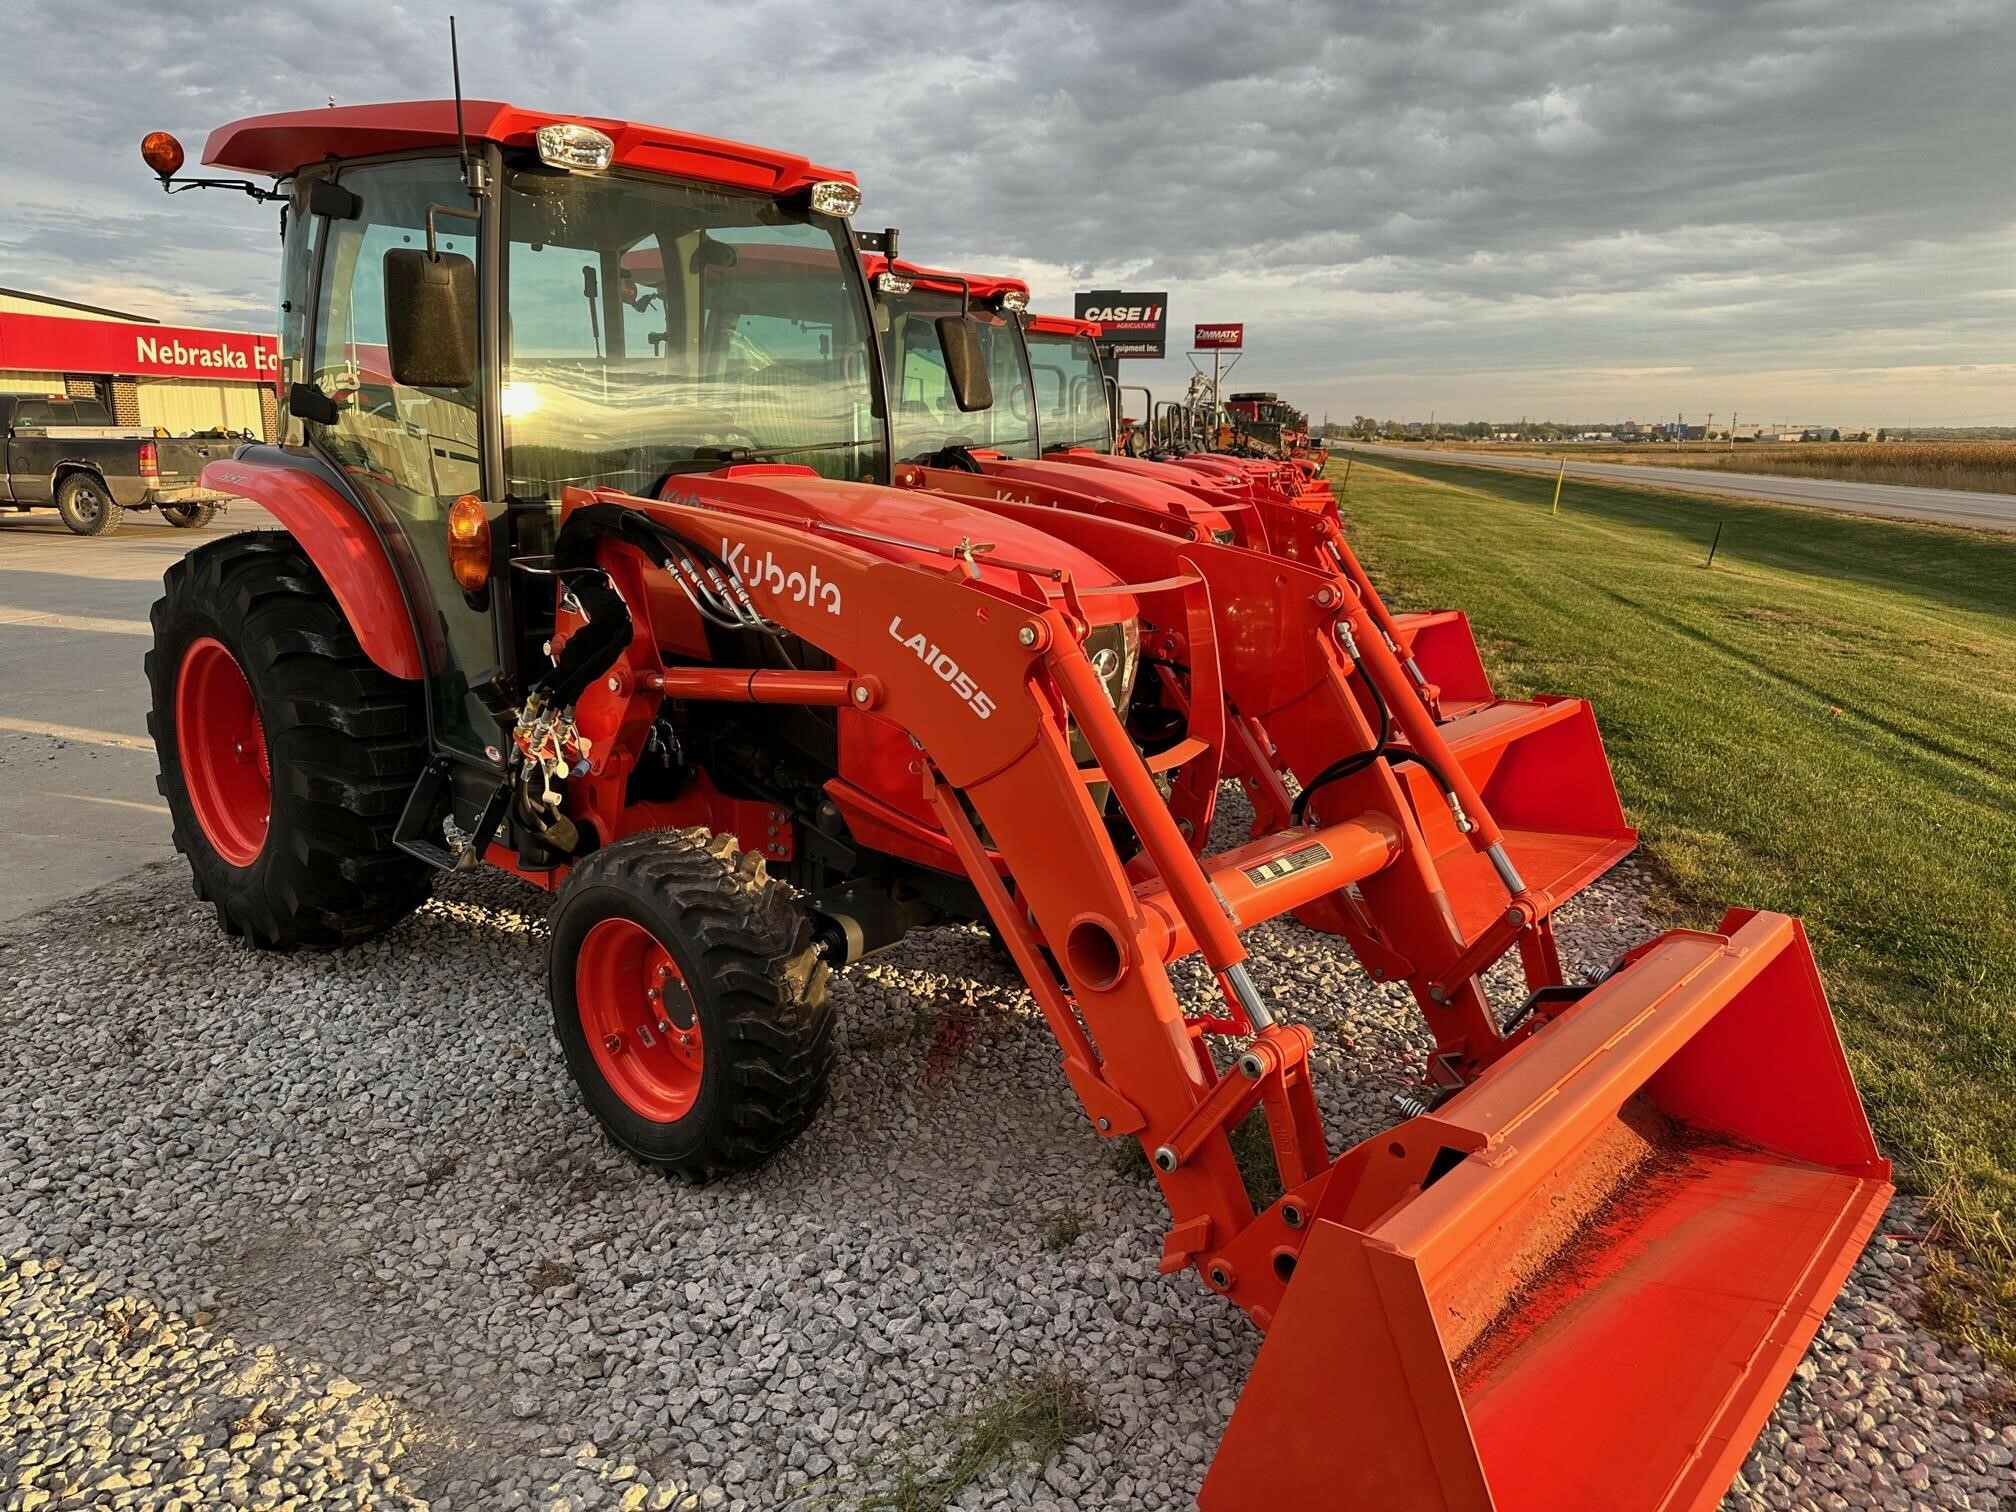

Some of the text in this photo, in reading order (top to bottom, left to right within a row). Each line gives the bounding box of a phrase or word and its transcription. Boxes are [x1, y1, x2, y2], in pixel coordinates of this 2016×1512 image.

[1085, 307, 1142, 321] CASE
[1196, 329, 1240, 339] ZIMMATIC
[136, 337, 248, 369] Nebraska
[1146, 344, 1159, 352] Inc.
[721, 537, 842, 616] Kubota
[888, 615, 997, 720] LA1055
